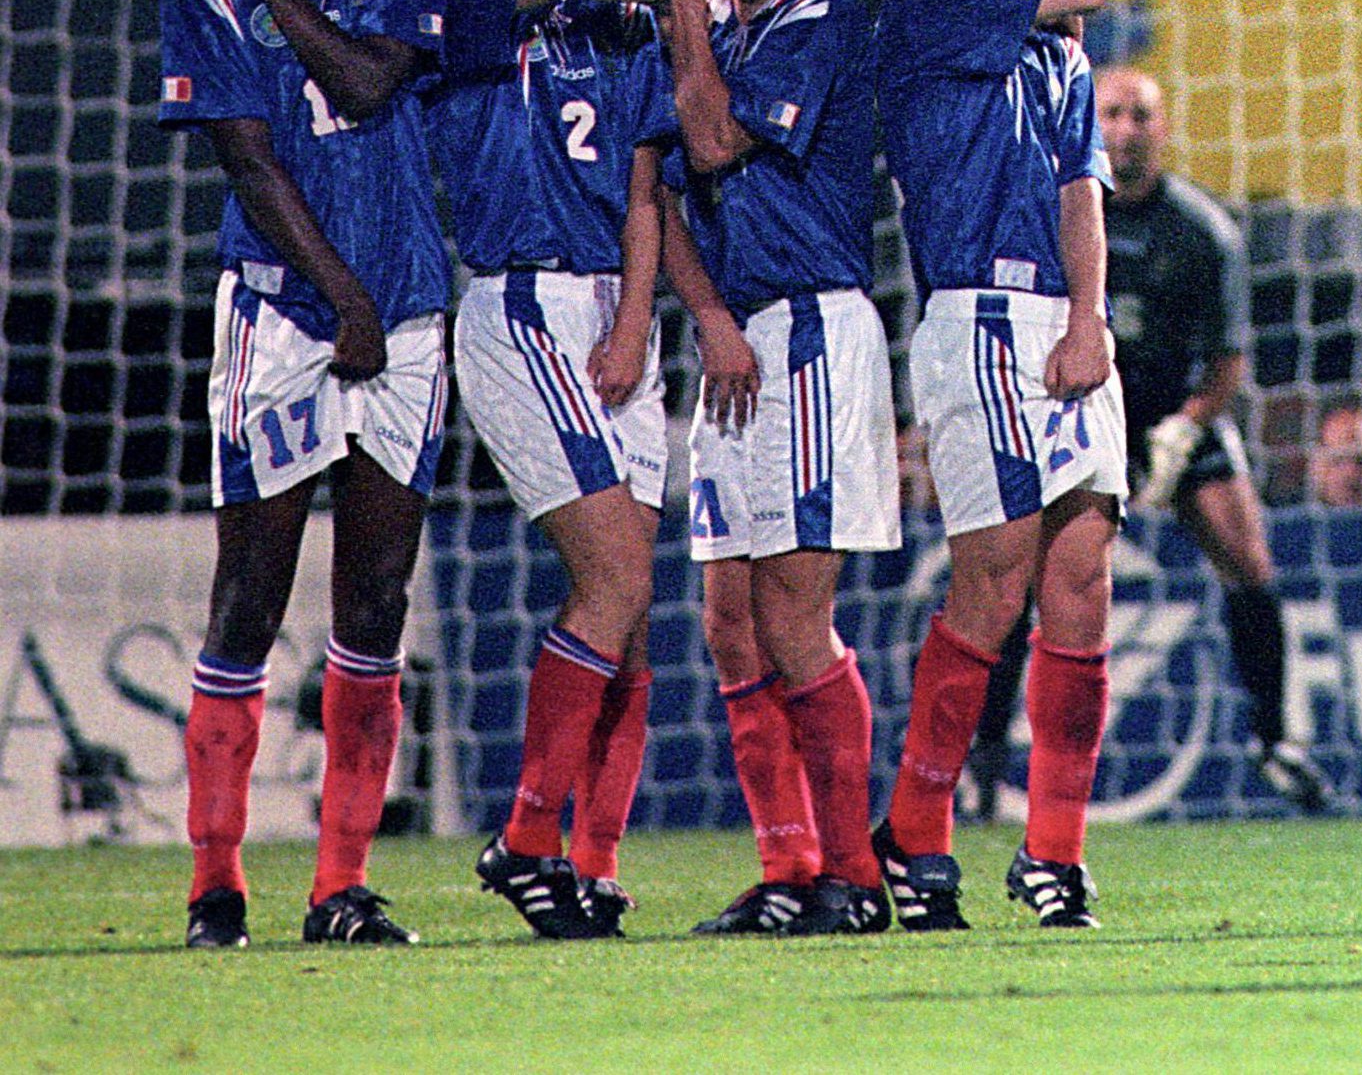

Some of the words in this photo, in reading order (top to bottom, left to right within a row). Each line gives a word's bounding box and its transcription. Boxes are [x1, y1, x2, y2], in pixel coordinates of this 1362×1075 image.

[302, 78, 358, 137] 1
[561, 100, 598, 161] 2
[261, 395, 321, 470] 17
